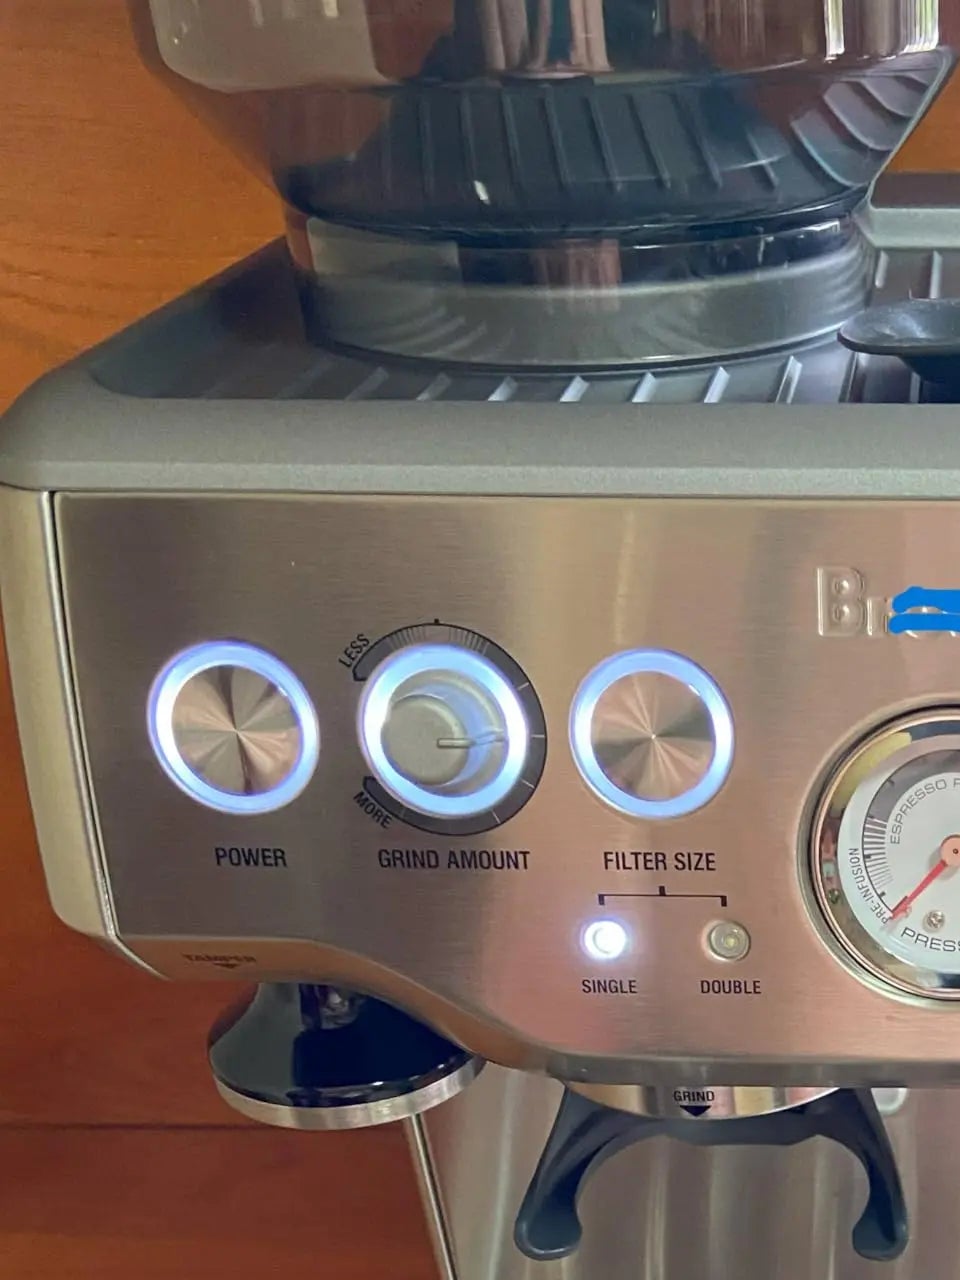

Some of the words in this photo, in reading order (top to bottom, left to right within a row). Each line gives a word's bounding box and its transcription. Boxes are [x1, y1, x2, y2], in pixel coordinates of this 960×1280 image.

[337, 632, 371, 668] LESS
[352, 789, 394, 830] MORE
[889, 778, 949, 845] ESPRESSO
[214, 846, 289, 868] POWER
[377, 849, 439, 870] GRIND
[447, 849, 531, 871] AMOUNT
[603, 851, 667, 872] FILTER
[673, 851, 717, 872] SIZE
[848, 847, 894, 926] PRE-INFUSION
[581, 979, 638, 994] SINGLE
[700, 979, 762, 995] DOUBLE
[673, 1090, 715, 1103] GRIND
